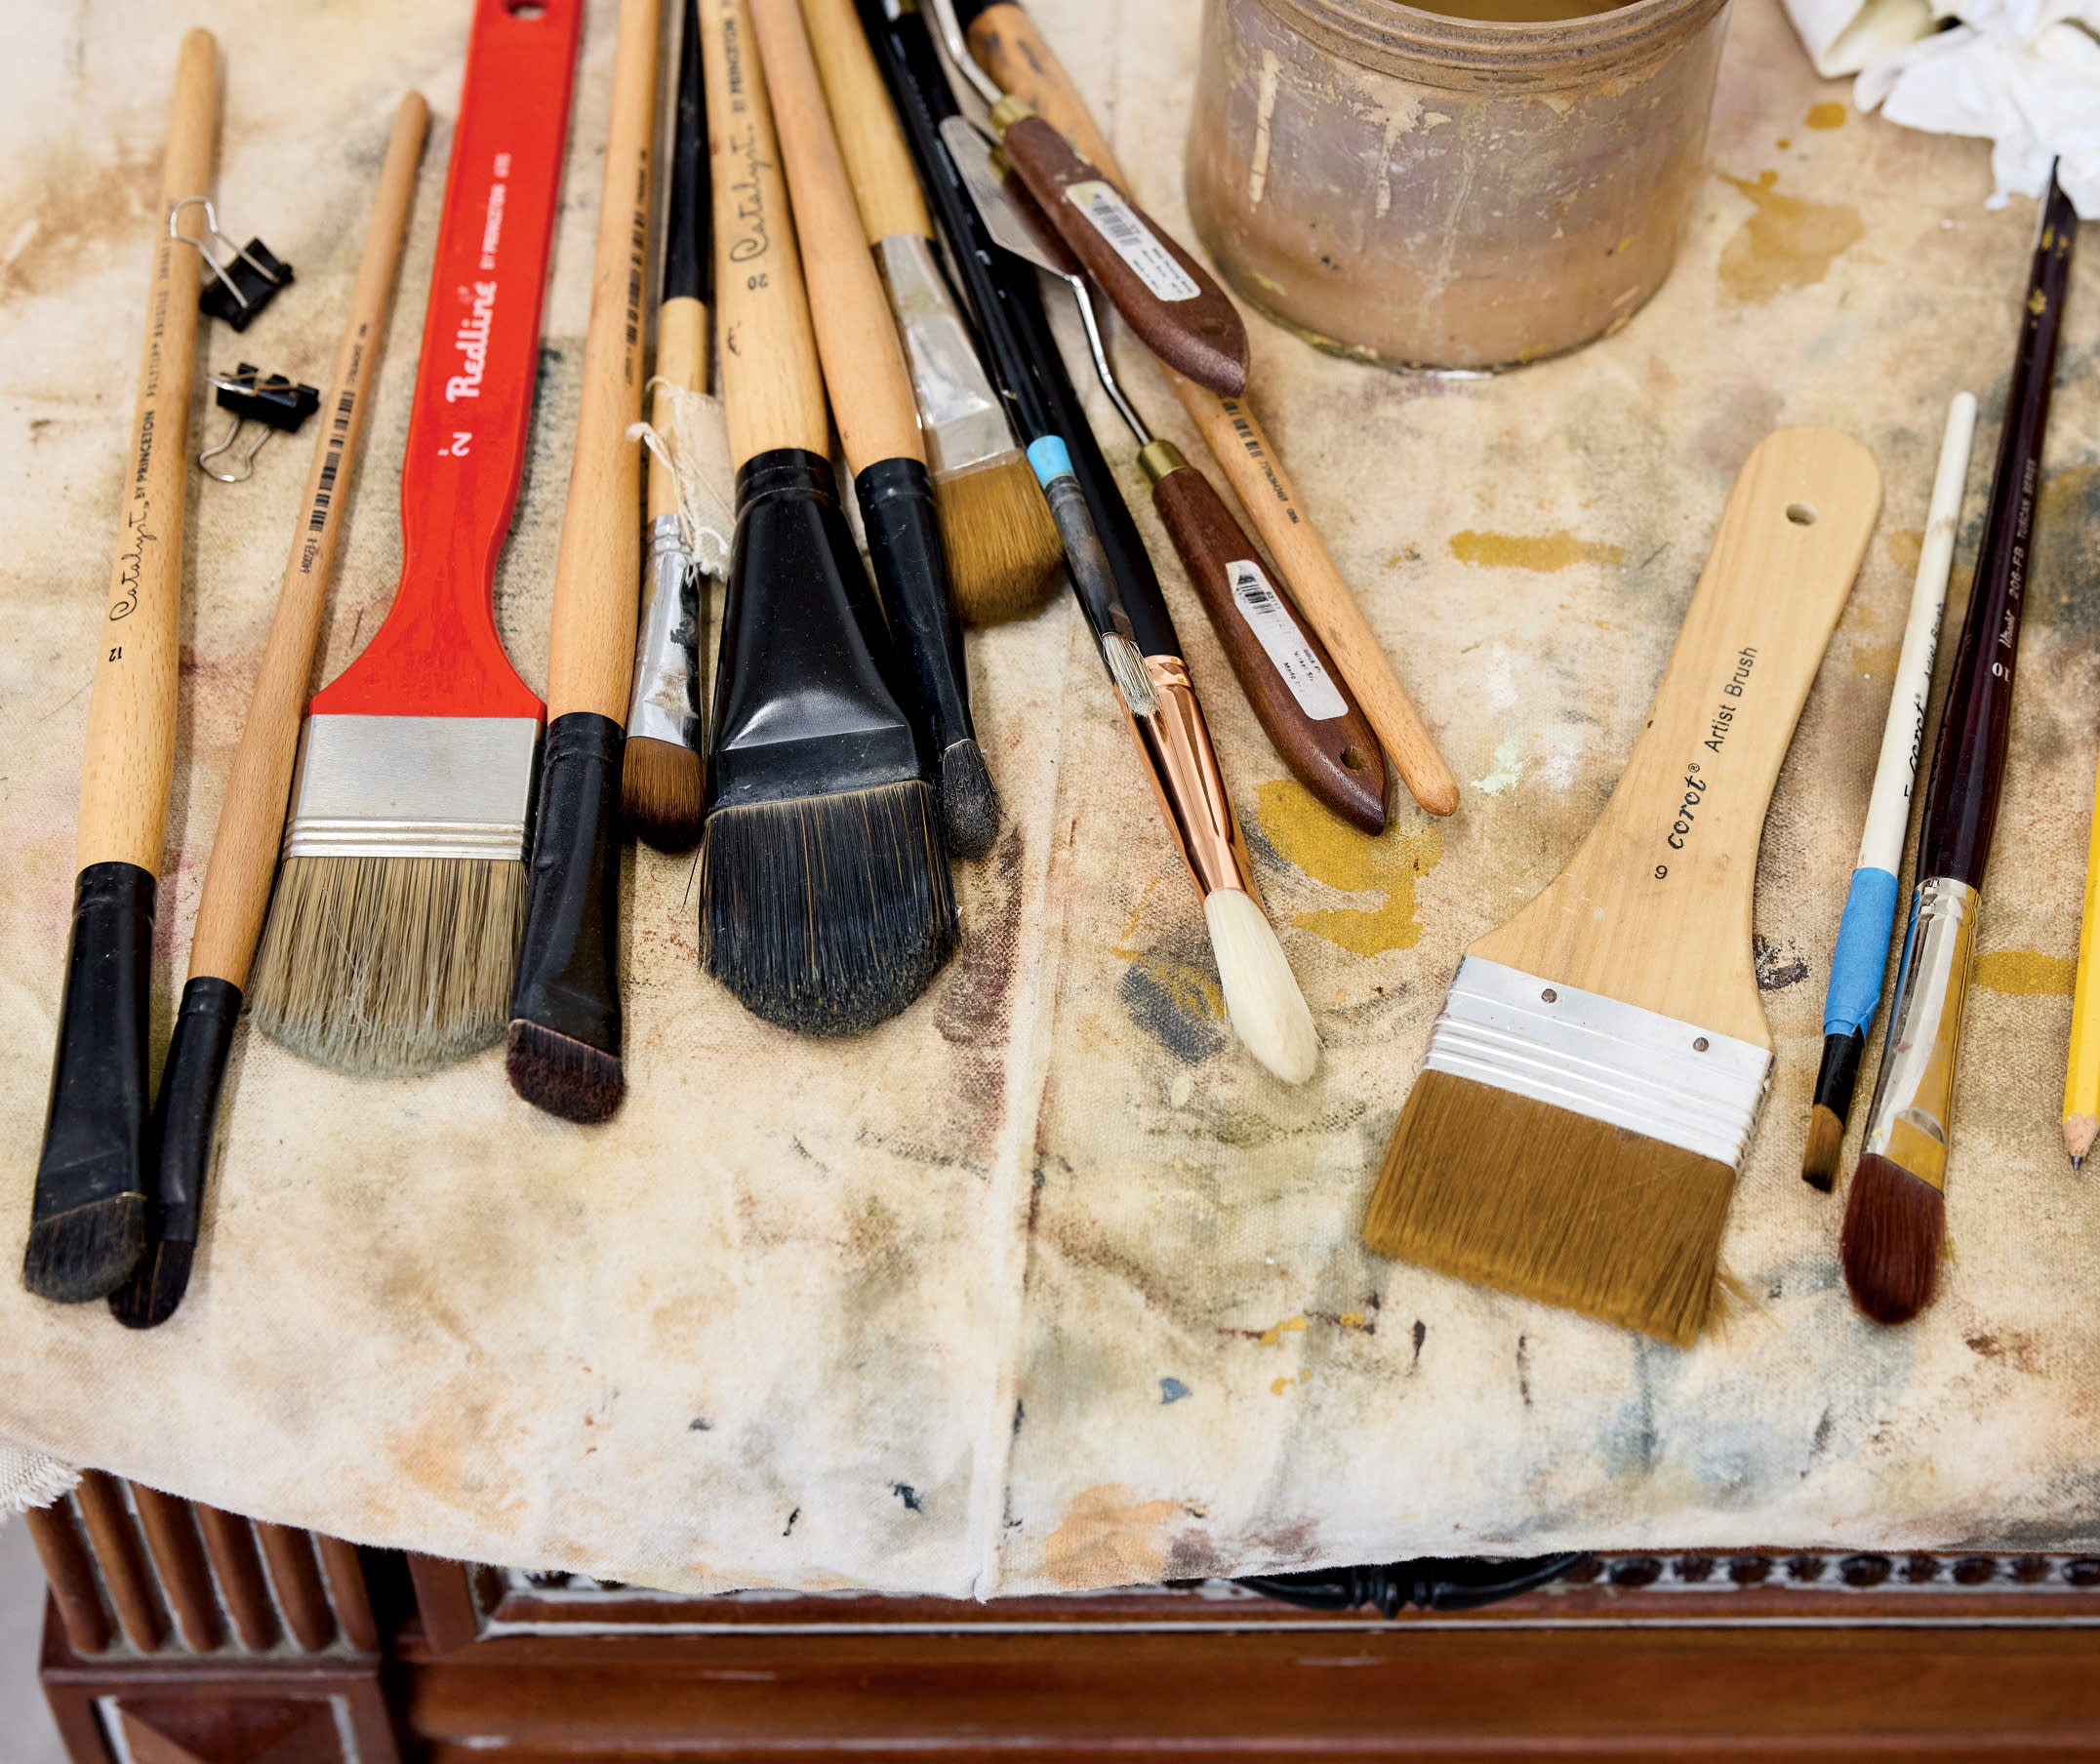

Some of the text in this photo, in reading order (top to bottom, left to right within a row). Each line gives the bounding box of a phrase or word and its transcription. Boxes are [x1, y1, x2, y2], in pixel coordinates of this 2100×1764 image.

[747, 273, 769, 291] 20
[446, 280, 497, 403] Redline
[137, 410, 154, 482] PRINCETON
[134, 487, 145, 500] BY
[108, 646, 123, 662] 12
[1992, 662, 2010, 683] 10
[1704, 704, 1736, 753] Artist
[1724, 646, 1757, 698] Brush
